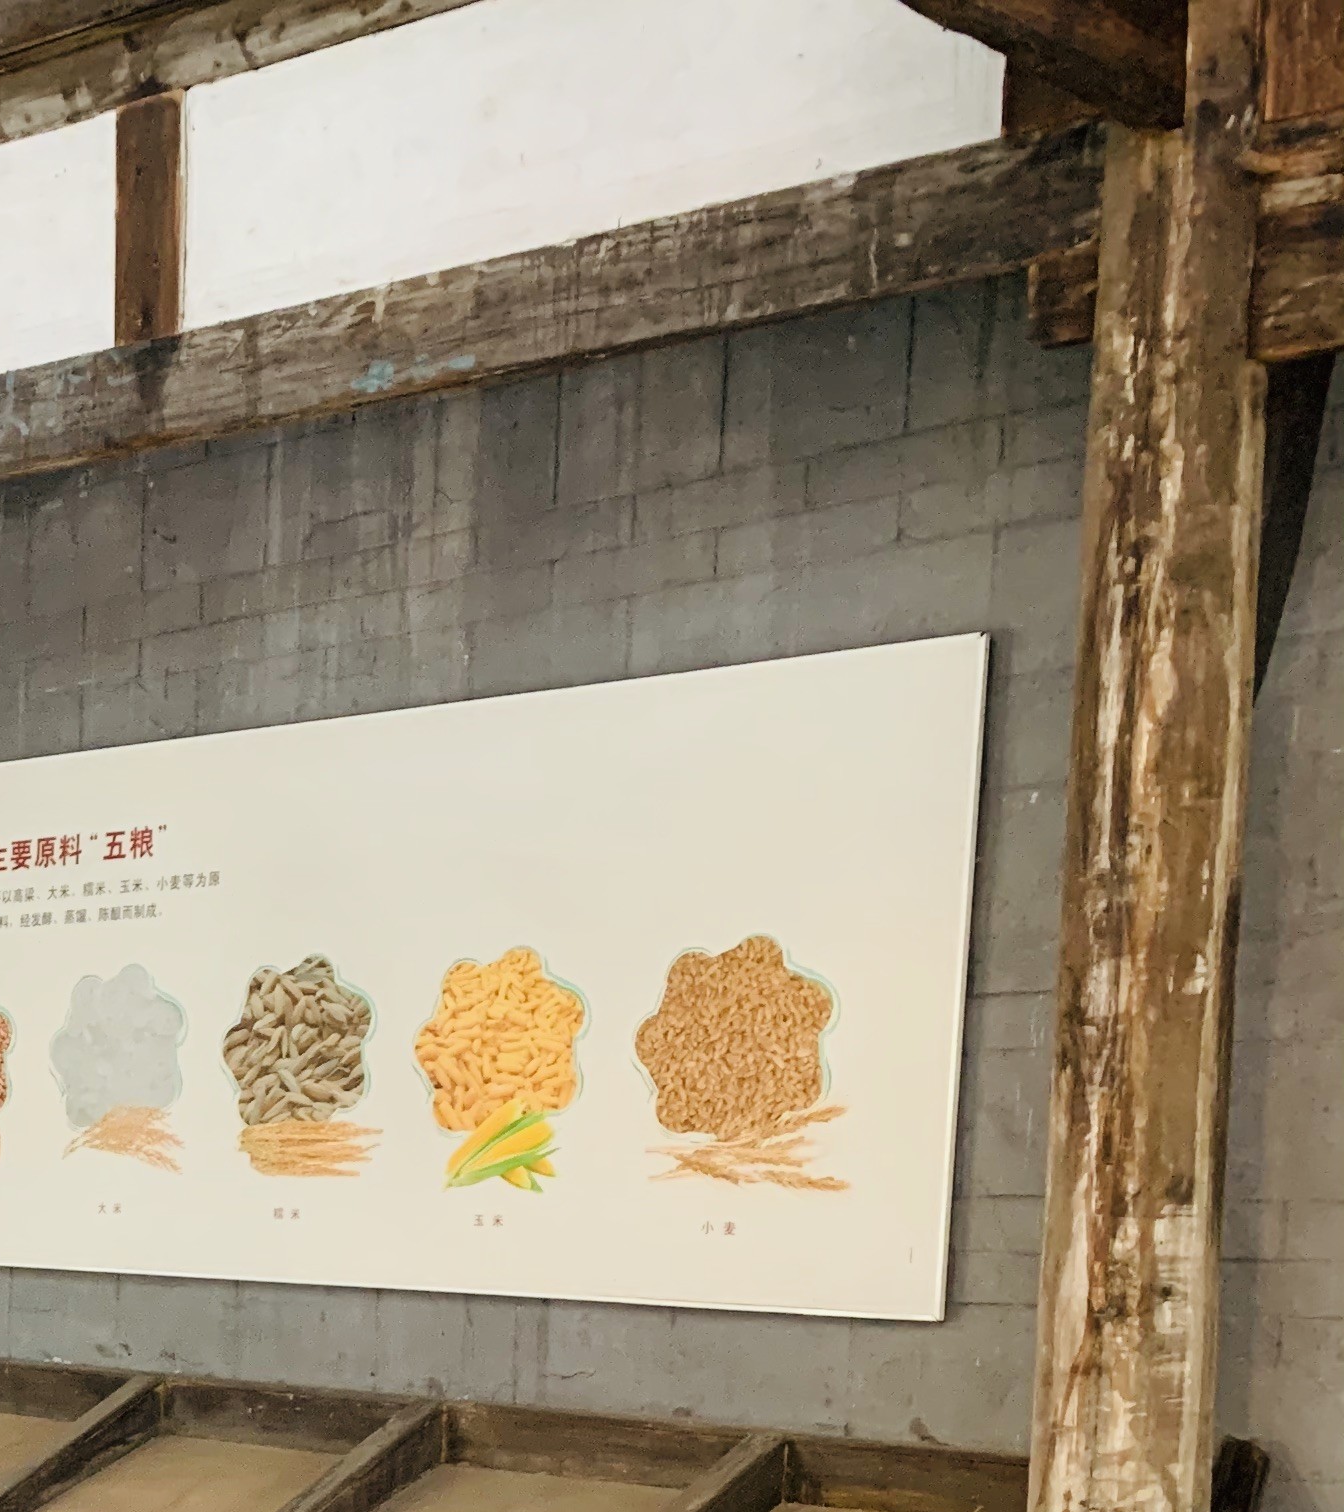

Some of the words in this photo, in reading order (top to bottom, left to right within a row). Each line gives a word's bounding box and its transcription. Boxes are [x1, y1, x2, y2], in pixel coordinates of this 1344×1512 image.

[98, 1202, 122, 1214] 大米
[473, 1214, 504, 1227] 玉米
[701, 1220, 736, 1236] 小麦
